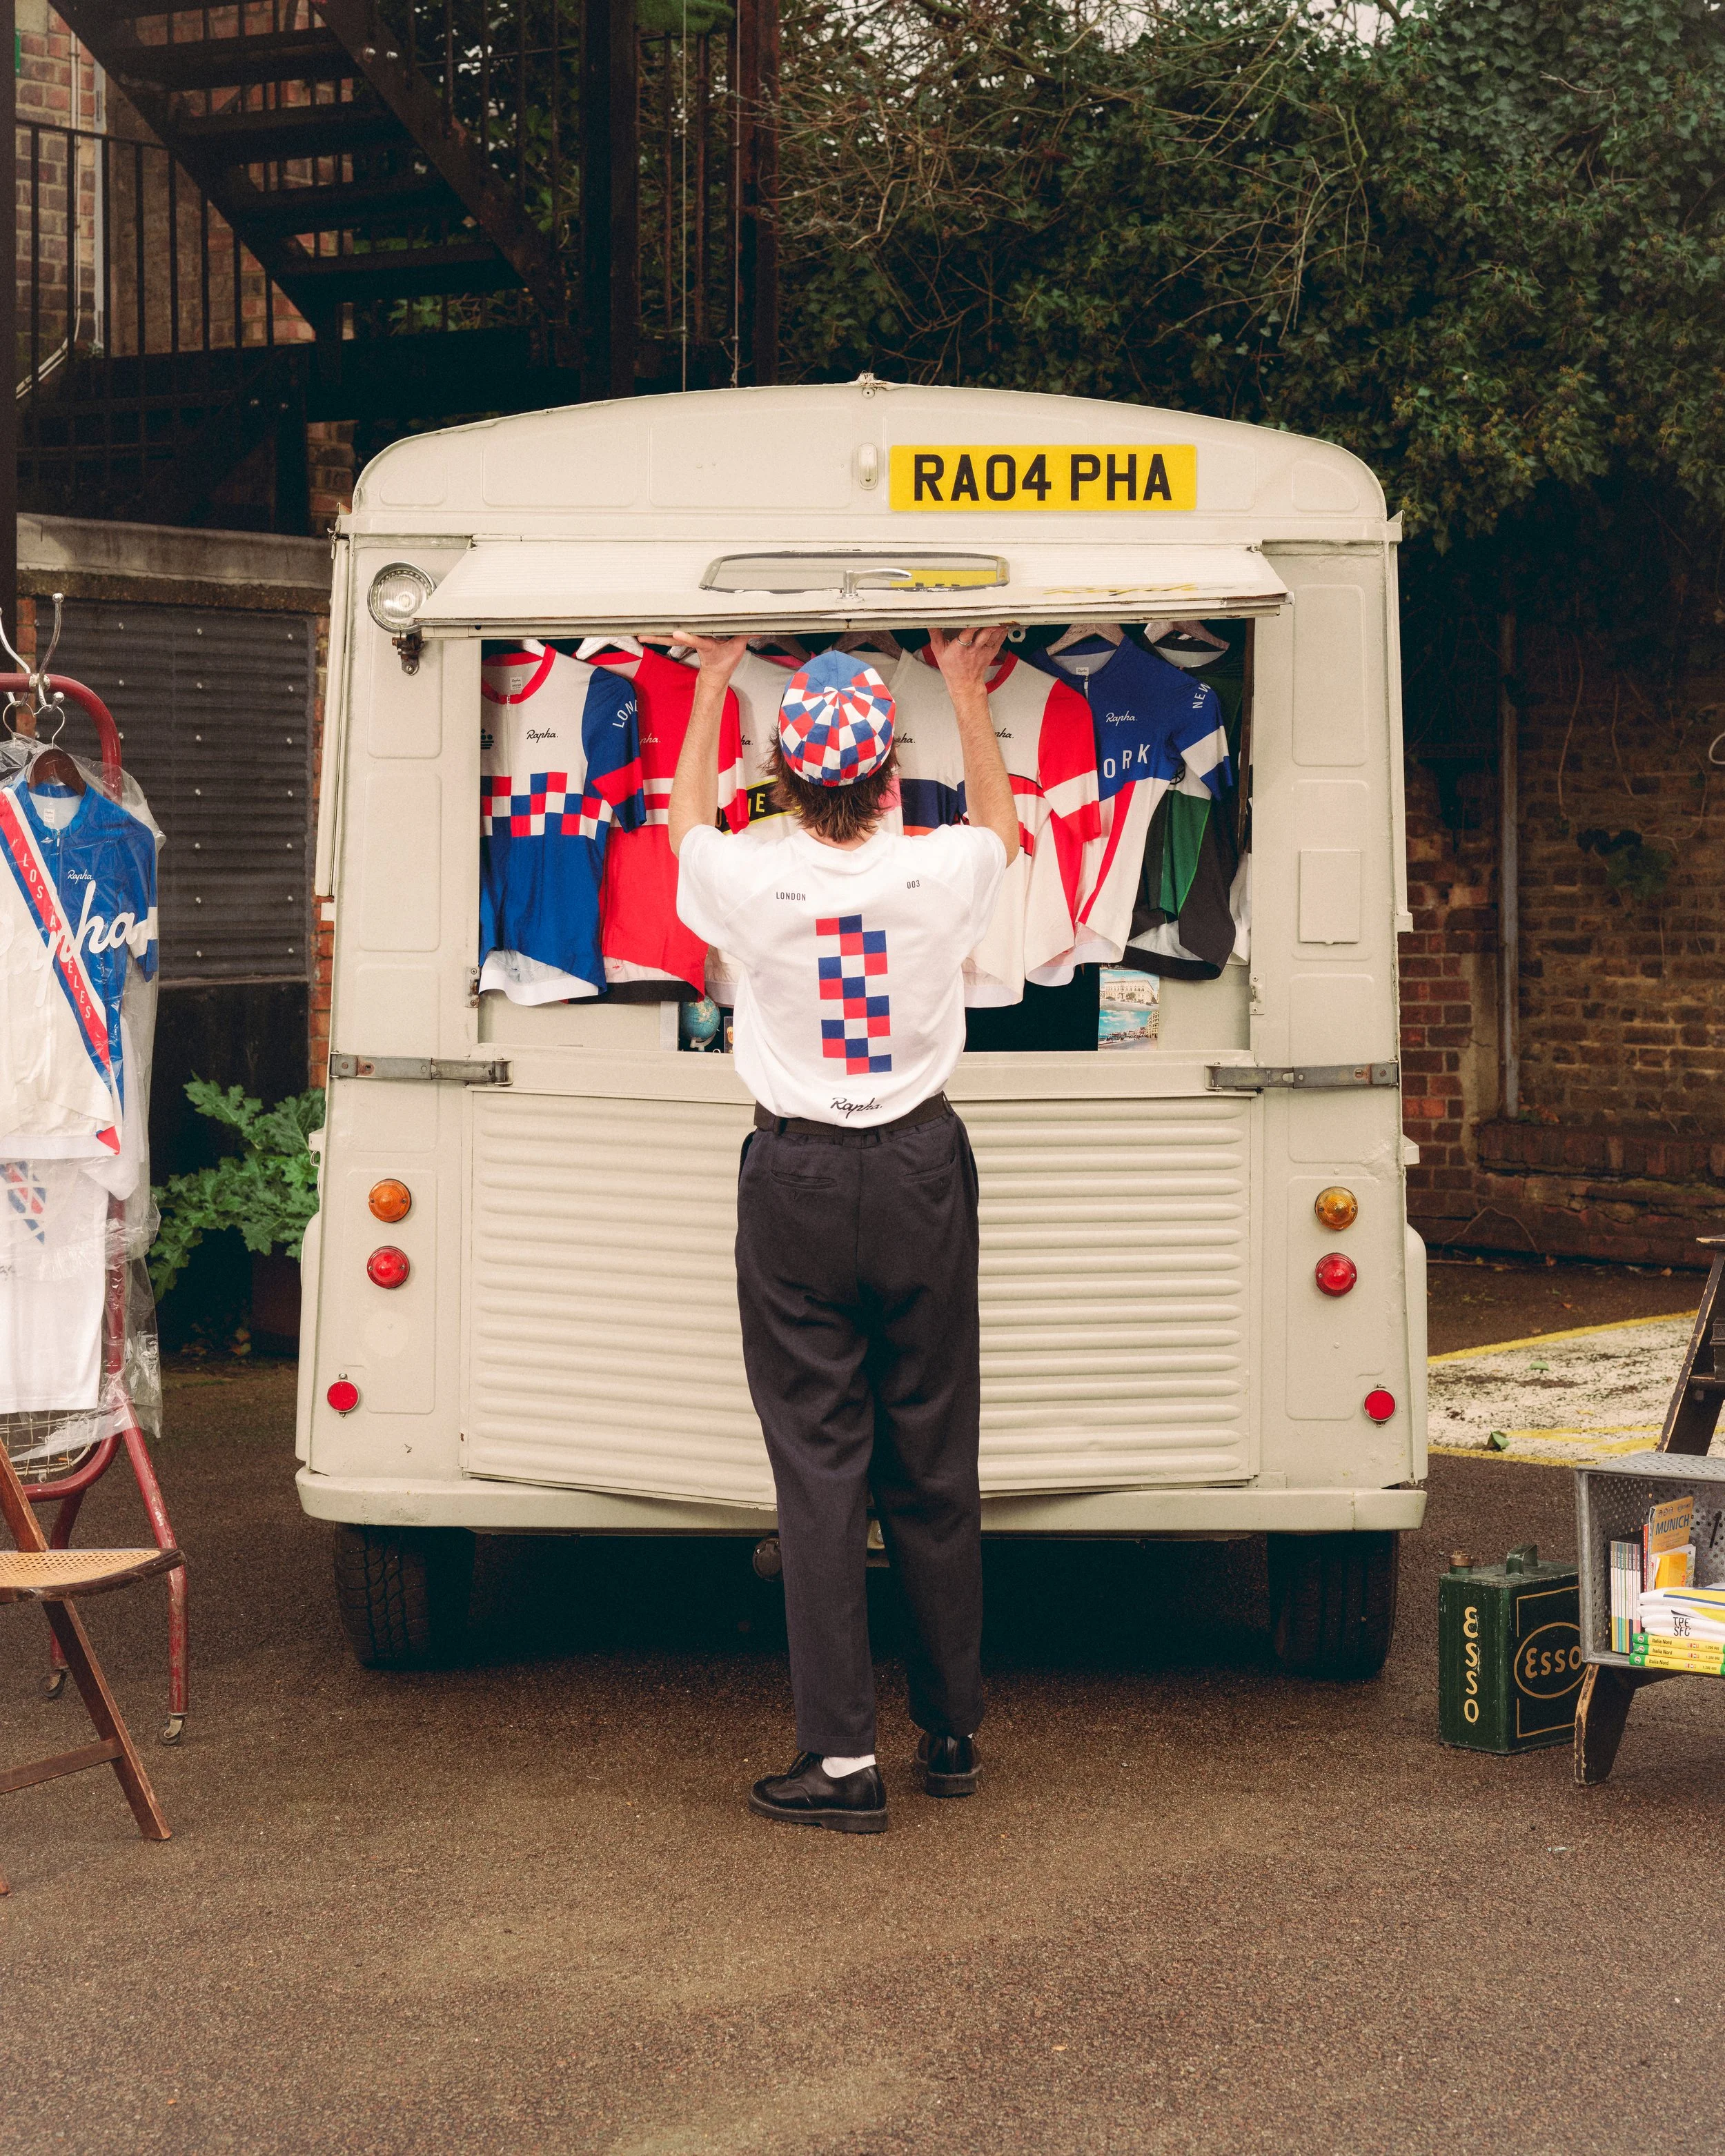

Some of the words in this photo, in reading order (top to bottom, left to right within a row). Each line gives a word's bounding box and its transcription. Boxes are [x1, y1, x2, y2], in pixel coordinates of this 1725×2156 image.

[1071, 454, 1172, 501] PHA
[1192, 683, 1211, 709] NEW
[612, 699, 638, 728] LON
[1105, 711, 1138, 726] Rapha.
[526, 727, 559, 743] Rapha.
[639, 733, 661, 746] pha.
[1104, 744, 1150, 778] ORK
[776, 891, 806, 901] LONDON
[907, 880, 920, 889] 003
[23, 853, 43, 899] LOS
[50, 914, 90, 1018] AELES
[1655, 1514, 1690, 1535] MUNICH
[1673, 1616, 1690, 1628] TPE
[1463, 1606, 1479, 1723] ESSO
[1525, 1645, 1582, 1679] ESSO
